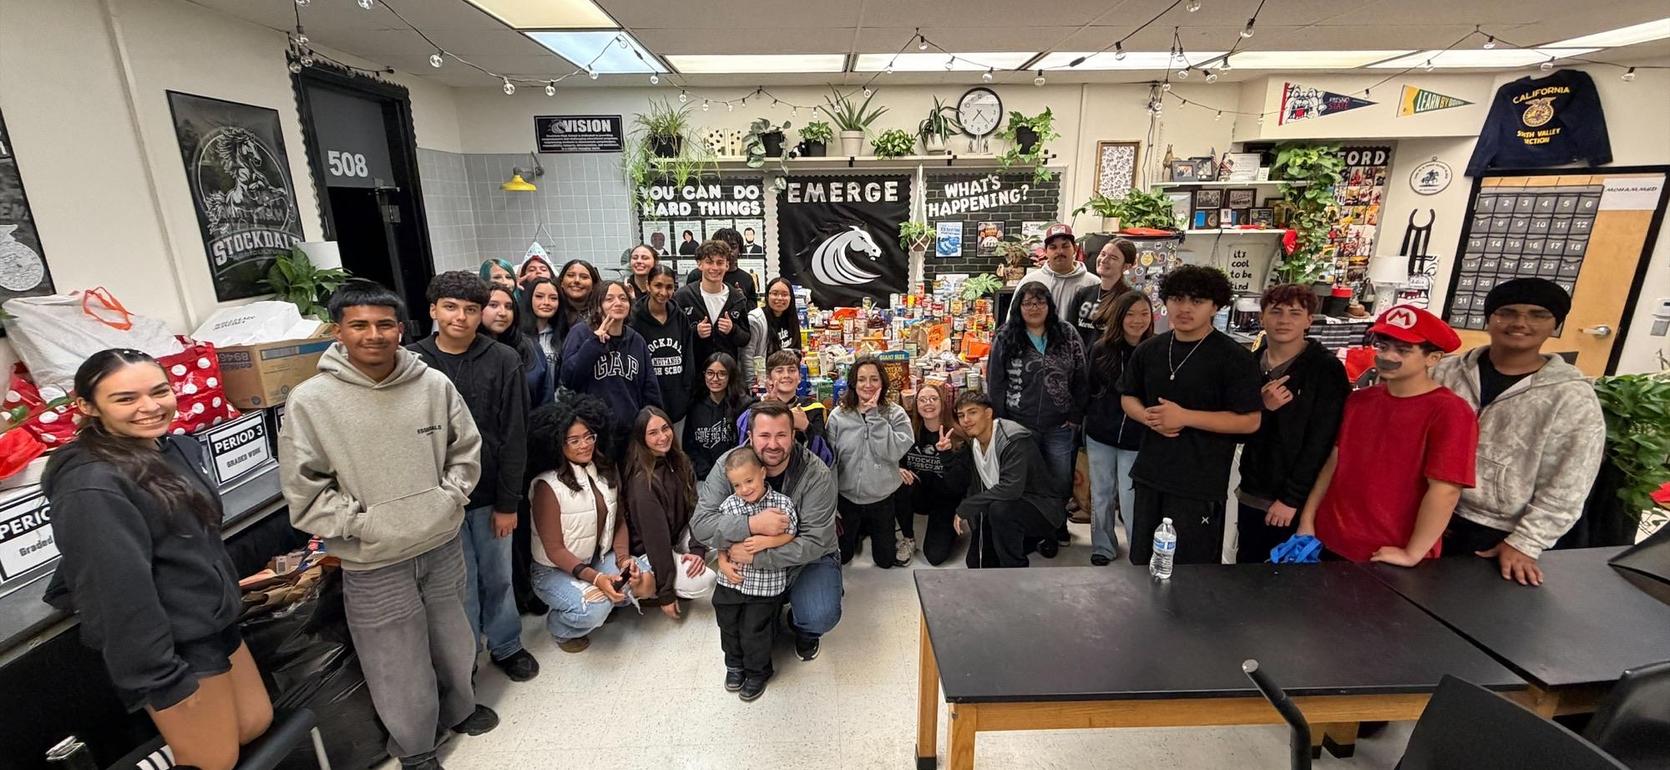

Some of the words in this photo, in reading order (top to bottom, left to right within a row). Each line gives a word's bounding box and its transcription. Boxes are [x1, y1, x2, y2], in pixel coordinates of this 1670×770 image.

[1415, 90, 1440, 112] LEARN
[1440, 96, 1449, 108] BY
[1512, 86, 1570, 104] CALIFORNIA
[1328, 102, 1349, 110] STATE
[563, 119, 612, 133] VISION
[1537, 127, 1561, 137] VALLEY
[328, 150, 369, 178] 508
[639, 185, 675, 200] YOU
[682, 184, 721, 200] CAN
[733, 185, 760, 200] DO
[787, 181, 899, 203] EMERGE
[944, 174, 1001, 199] WHAT'S
[642, 201, 691, 216] HARD
[697, 200, 761, 216] THINGS
[928, 184, 1029, 217] HAPPENING?
[1503, 199, 1511, 207] 2
[1522, 199, 1529, 207] 3
[1541, 199, 1548, 207] 4
[1585, 200, 1592, 208] 6
[1509, 240, 1520, 248] 15
[1550, 242, 1562, 250] 17
[1231, 259, 1249, 268] cool
[1230, 270, 1240, 279] to
[1242, 270, 1252, 279] be
[1388, 309, 1411, 326] M
[647, 337, 682, 354] OCKDAL
[594, 350, 640, 381] GAP
[664, 365, 683, 376] SCHO
[214, 428, 256, 454] PERIOD
[256, 425, 263, 436] 3
[226, 453, 248, 468] GRADED
[0, 506, 51, 540] PERIO
[19, 534, 54, 557] Graded
